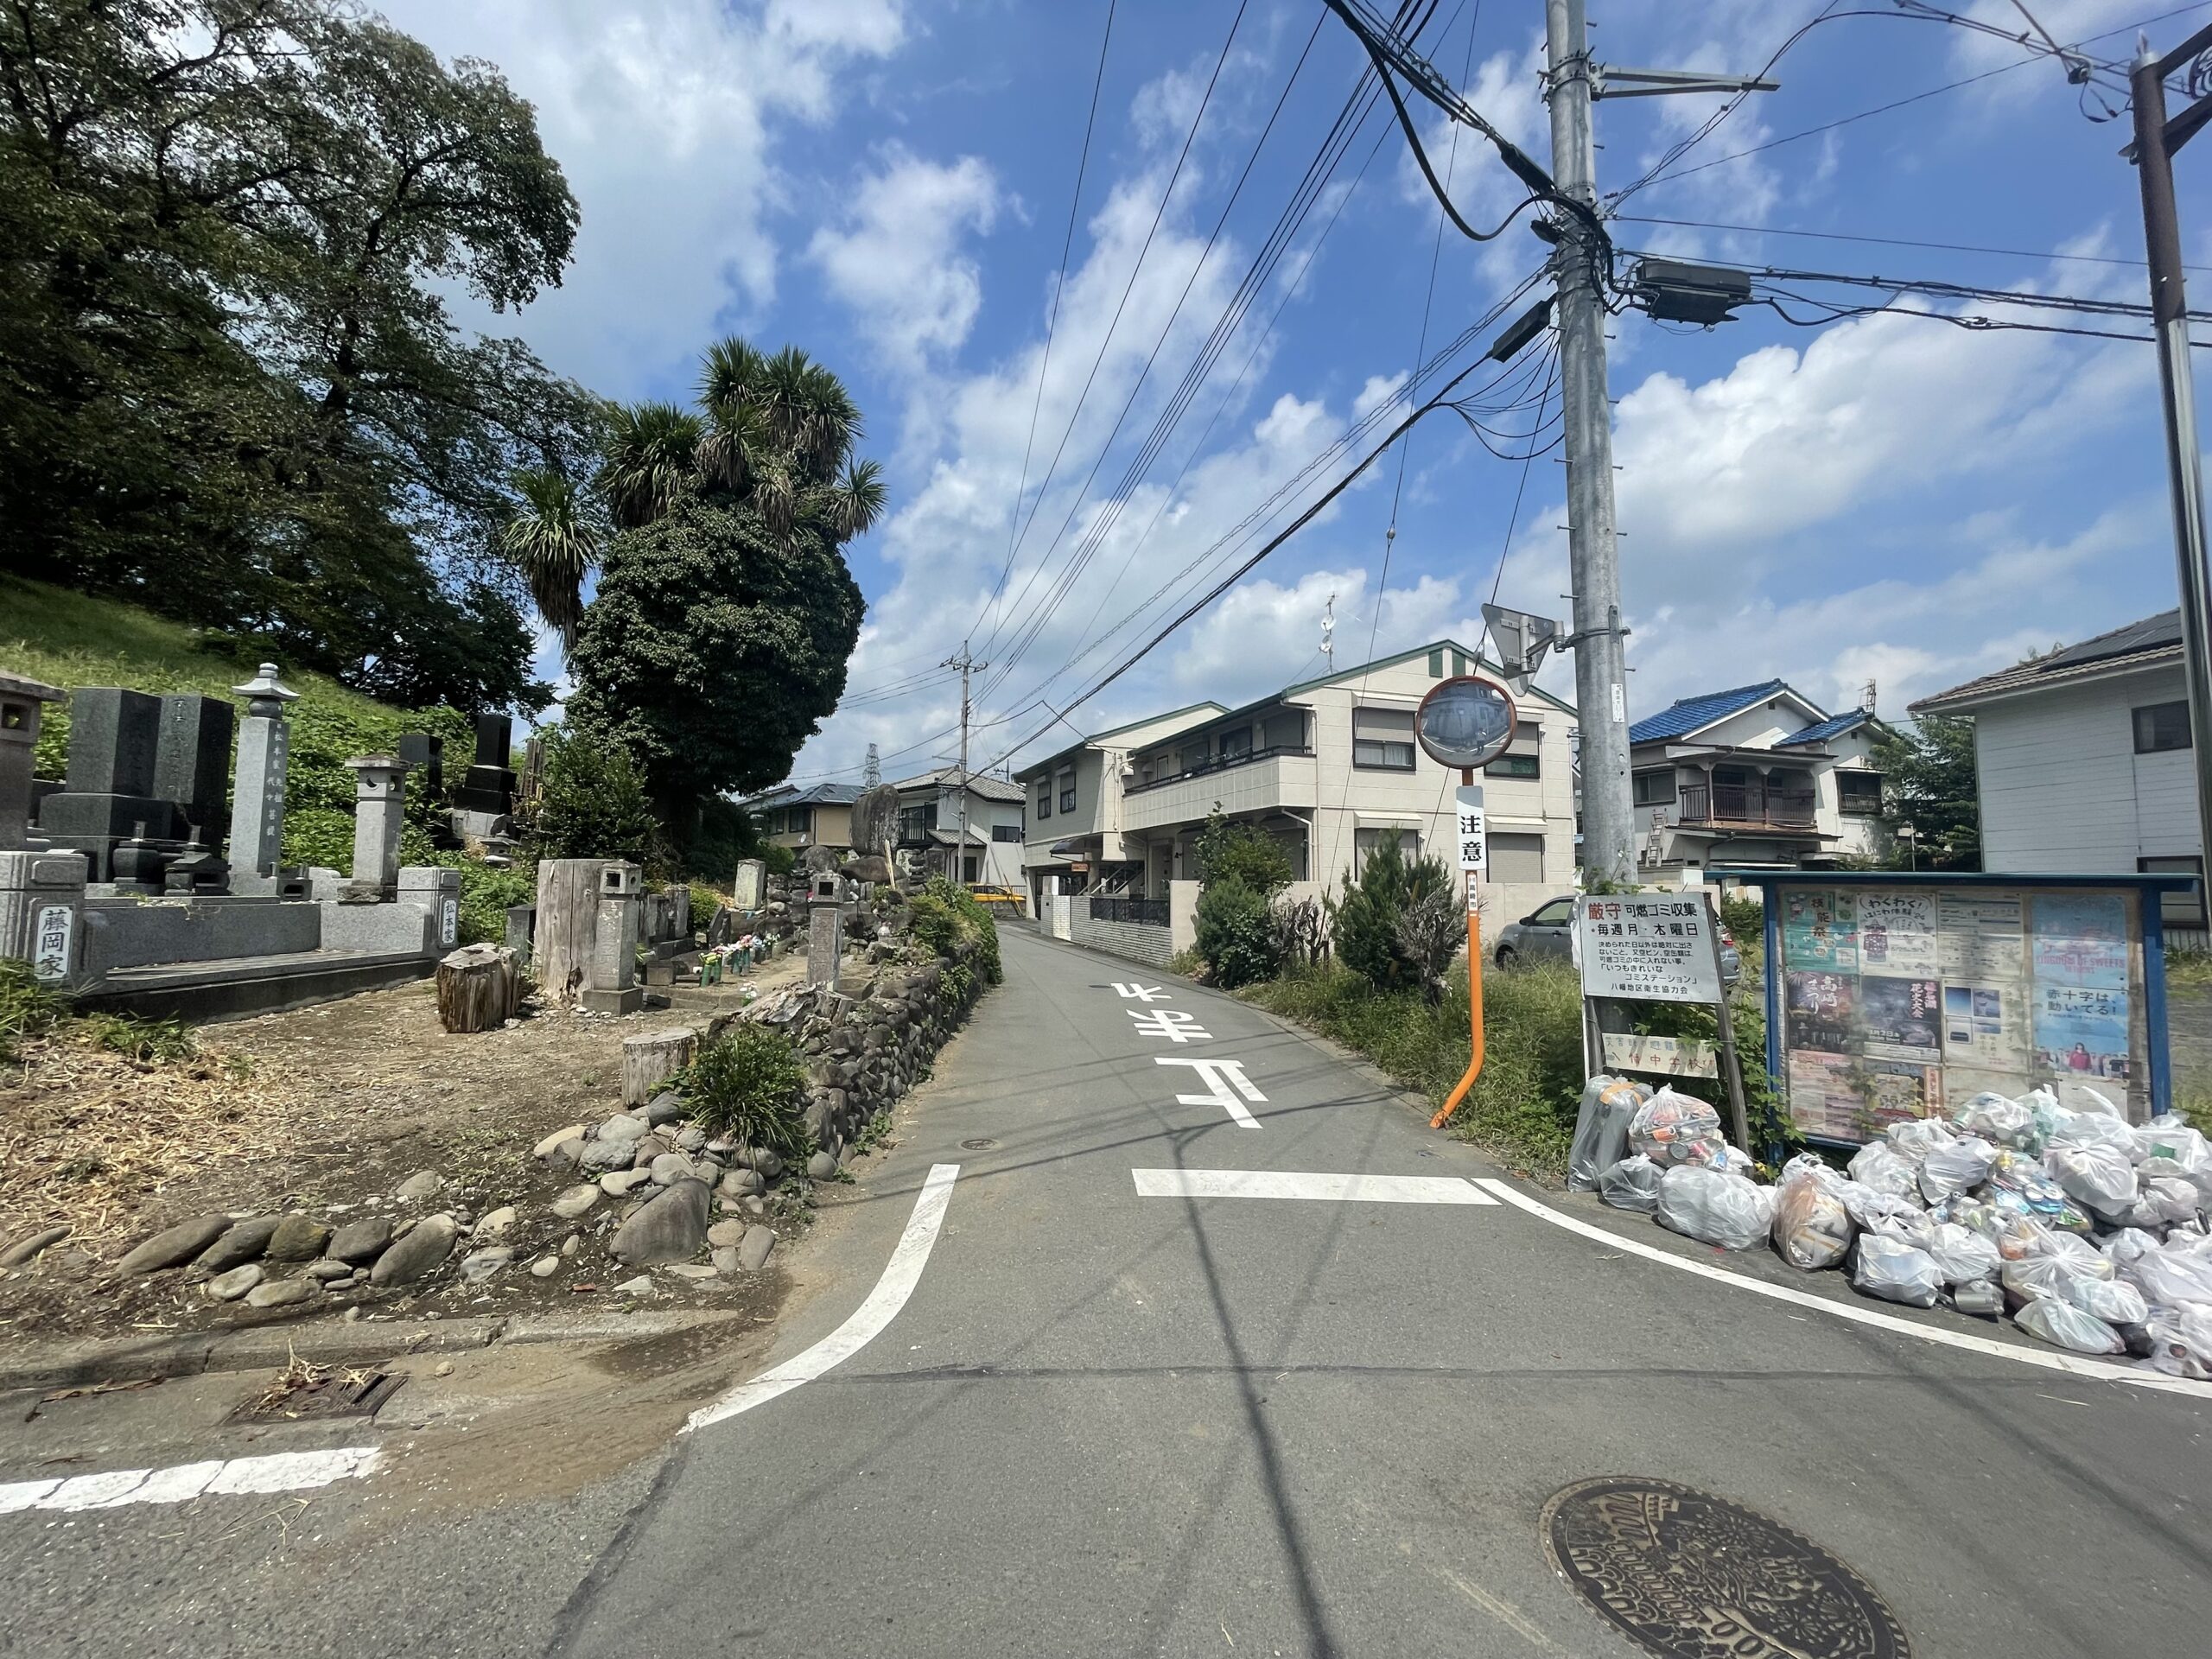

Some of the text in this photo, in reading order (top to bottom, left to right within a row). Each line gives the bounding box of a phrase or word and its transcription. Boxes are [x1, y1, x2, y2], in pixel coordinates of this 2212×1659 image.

[1459, 815, 1482, 861] 注意
[444, 901, 455, 942] 松本家
[1588, 902, 1697, 920] 厳守 可燃ゴミ収集
[37, 908, 69, 976] 藤岡家
[1624, 973, 1699, 984] ゴミステーション」
[2089, 957, 2126, 969] SWEETS
[1611, 982, 1688, 995] 八幡地区衛生協力会
[1807, 978, 1820, 1014] まつり
[1820, 975, 1839, 1007] 高崎
[1910, 983, 1924, 1019] 花火大会
[2046, 989, 2117, 1004] 赤十字は、
[2047, 1001, 2117, 1015] 動いてる！
[1109, 982, 1269, 1129] 止まれ
